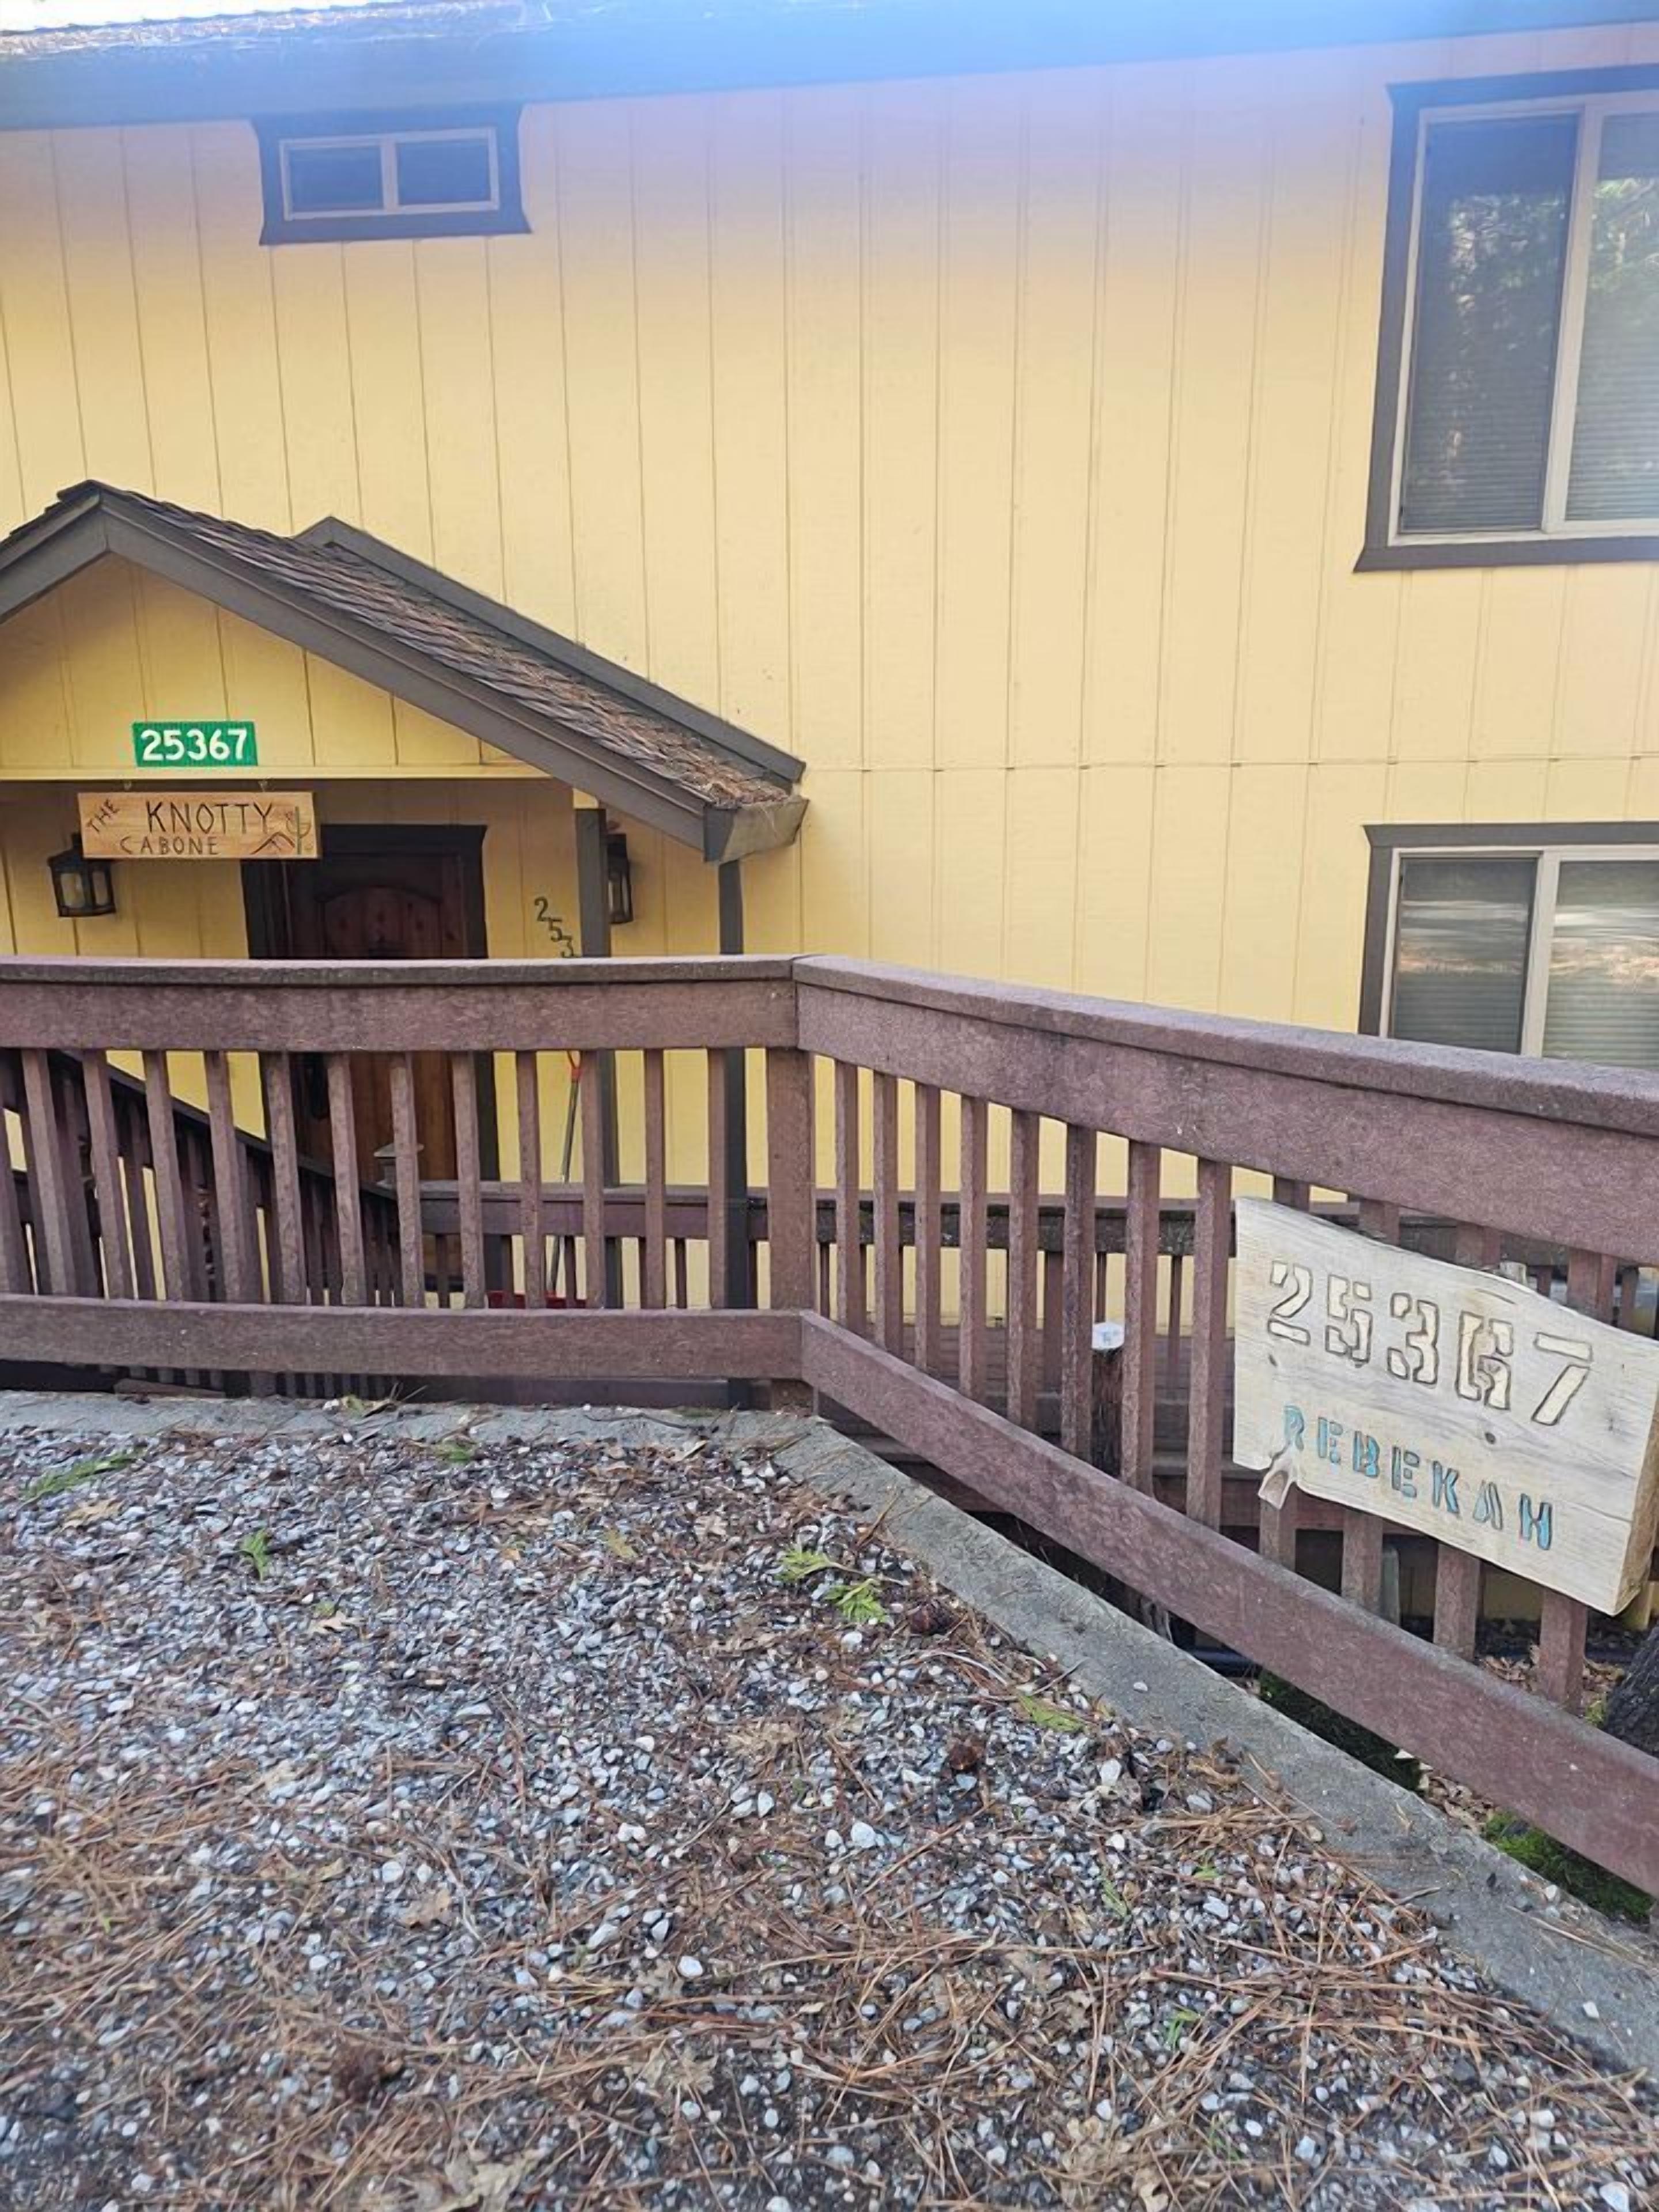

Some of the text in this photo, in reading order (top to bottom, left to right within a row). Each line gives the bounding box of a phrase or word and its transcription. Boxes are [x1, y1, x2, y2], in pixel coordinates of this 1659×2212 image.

[142, 728, 248, 761] 25367
[86, 798, 273, 834] THE KNOTTY
[120, 836, 219, 855] CABONE
[534, 896, 582, 957] 253
[1283, 1406, 1553, 1550] REBEKAH
